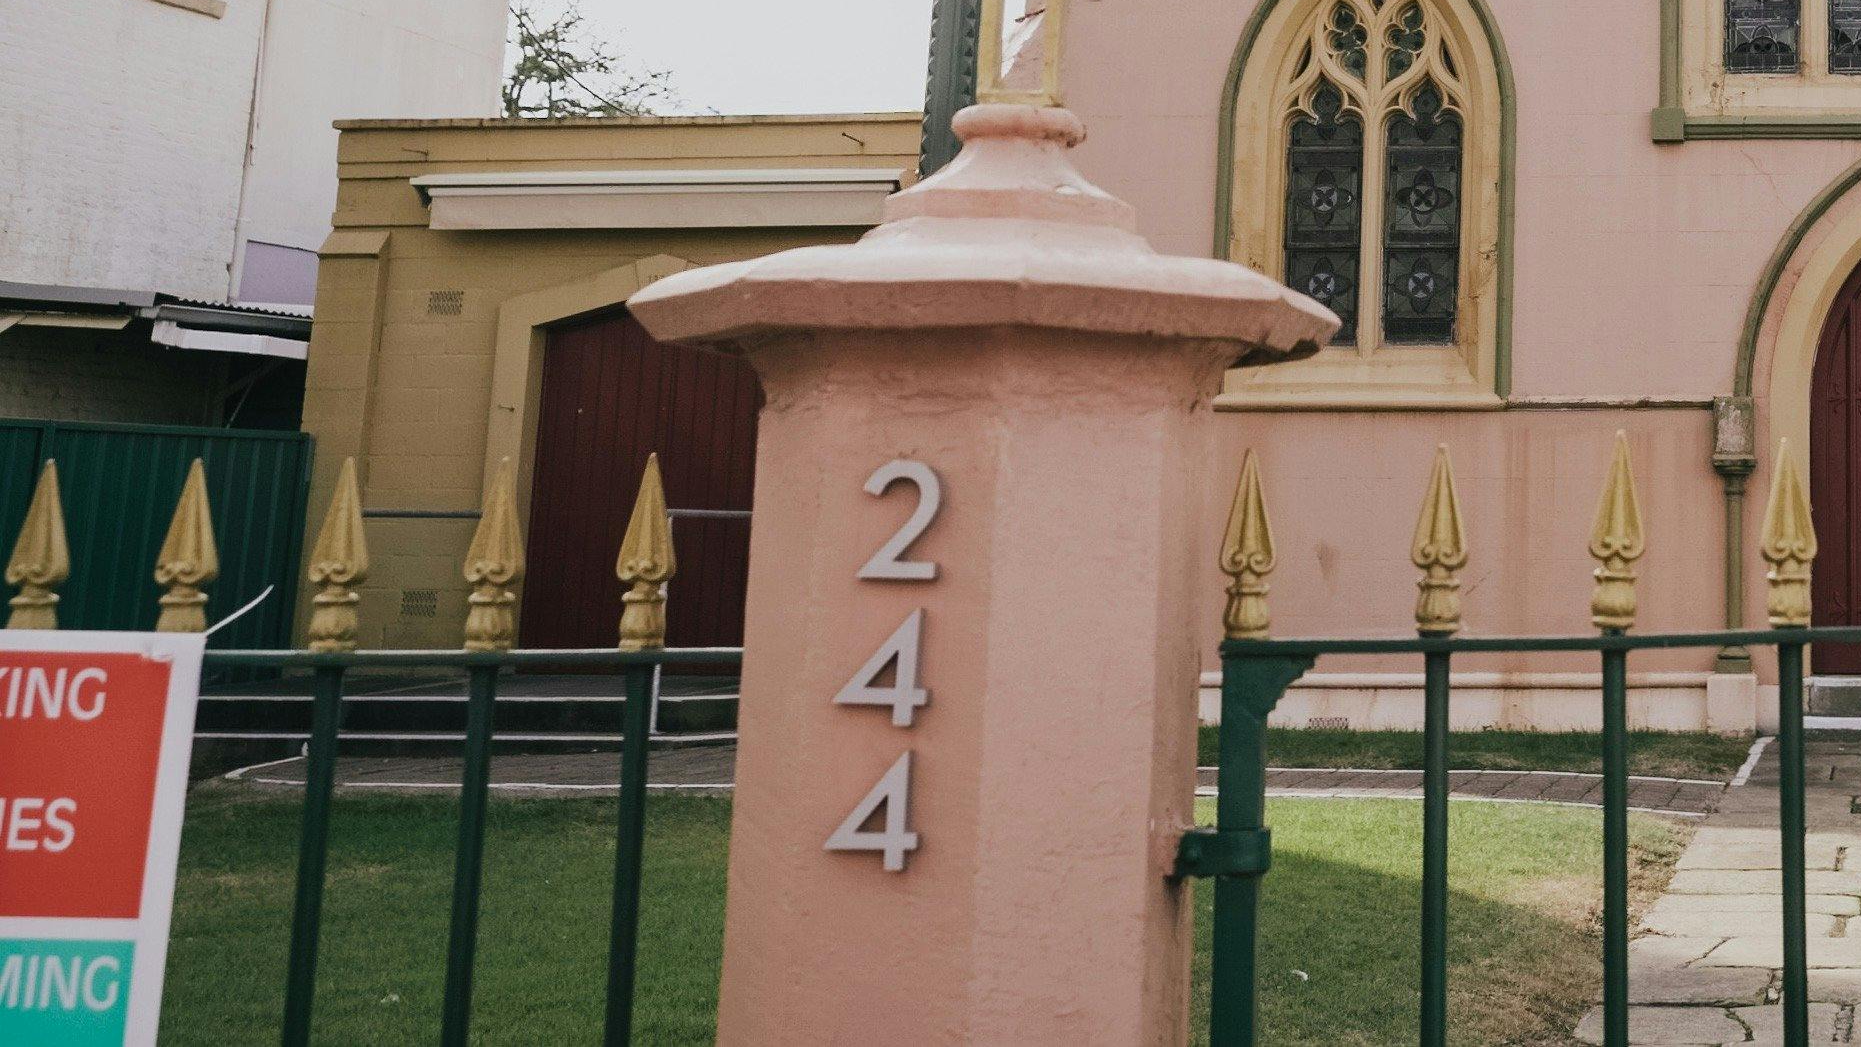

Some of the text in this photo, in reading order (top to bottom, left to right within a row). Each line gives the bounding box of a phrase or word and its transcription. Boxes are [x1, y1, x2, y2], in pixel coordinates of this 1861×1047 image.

[823, 459, 942, 872] 244
[0, 666, 107, 722] ING
[0, 797, 77, 852] ES
